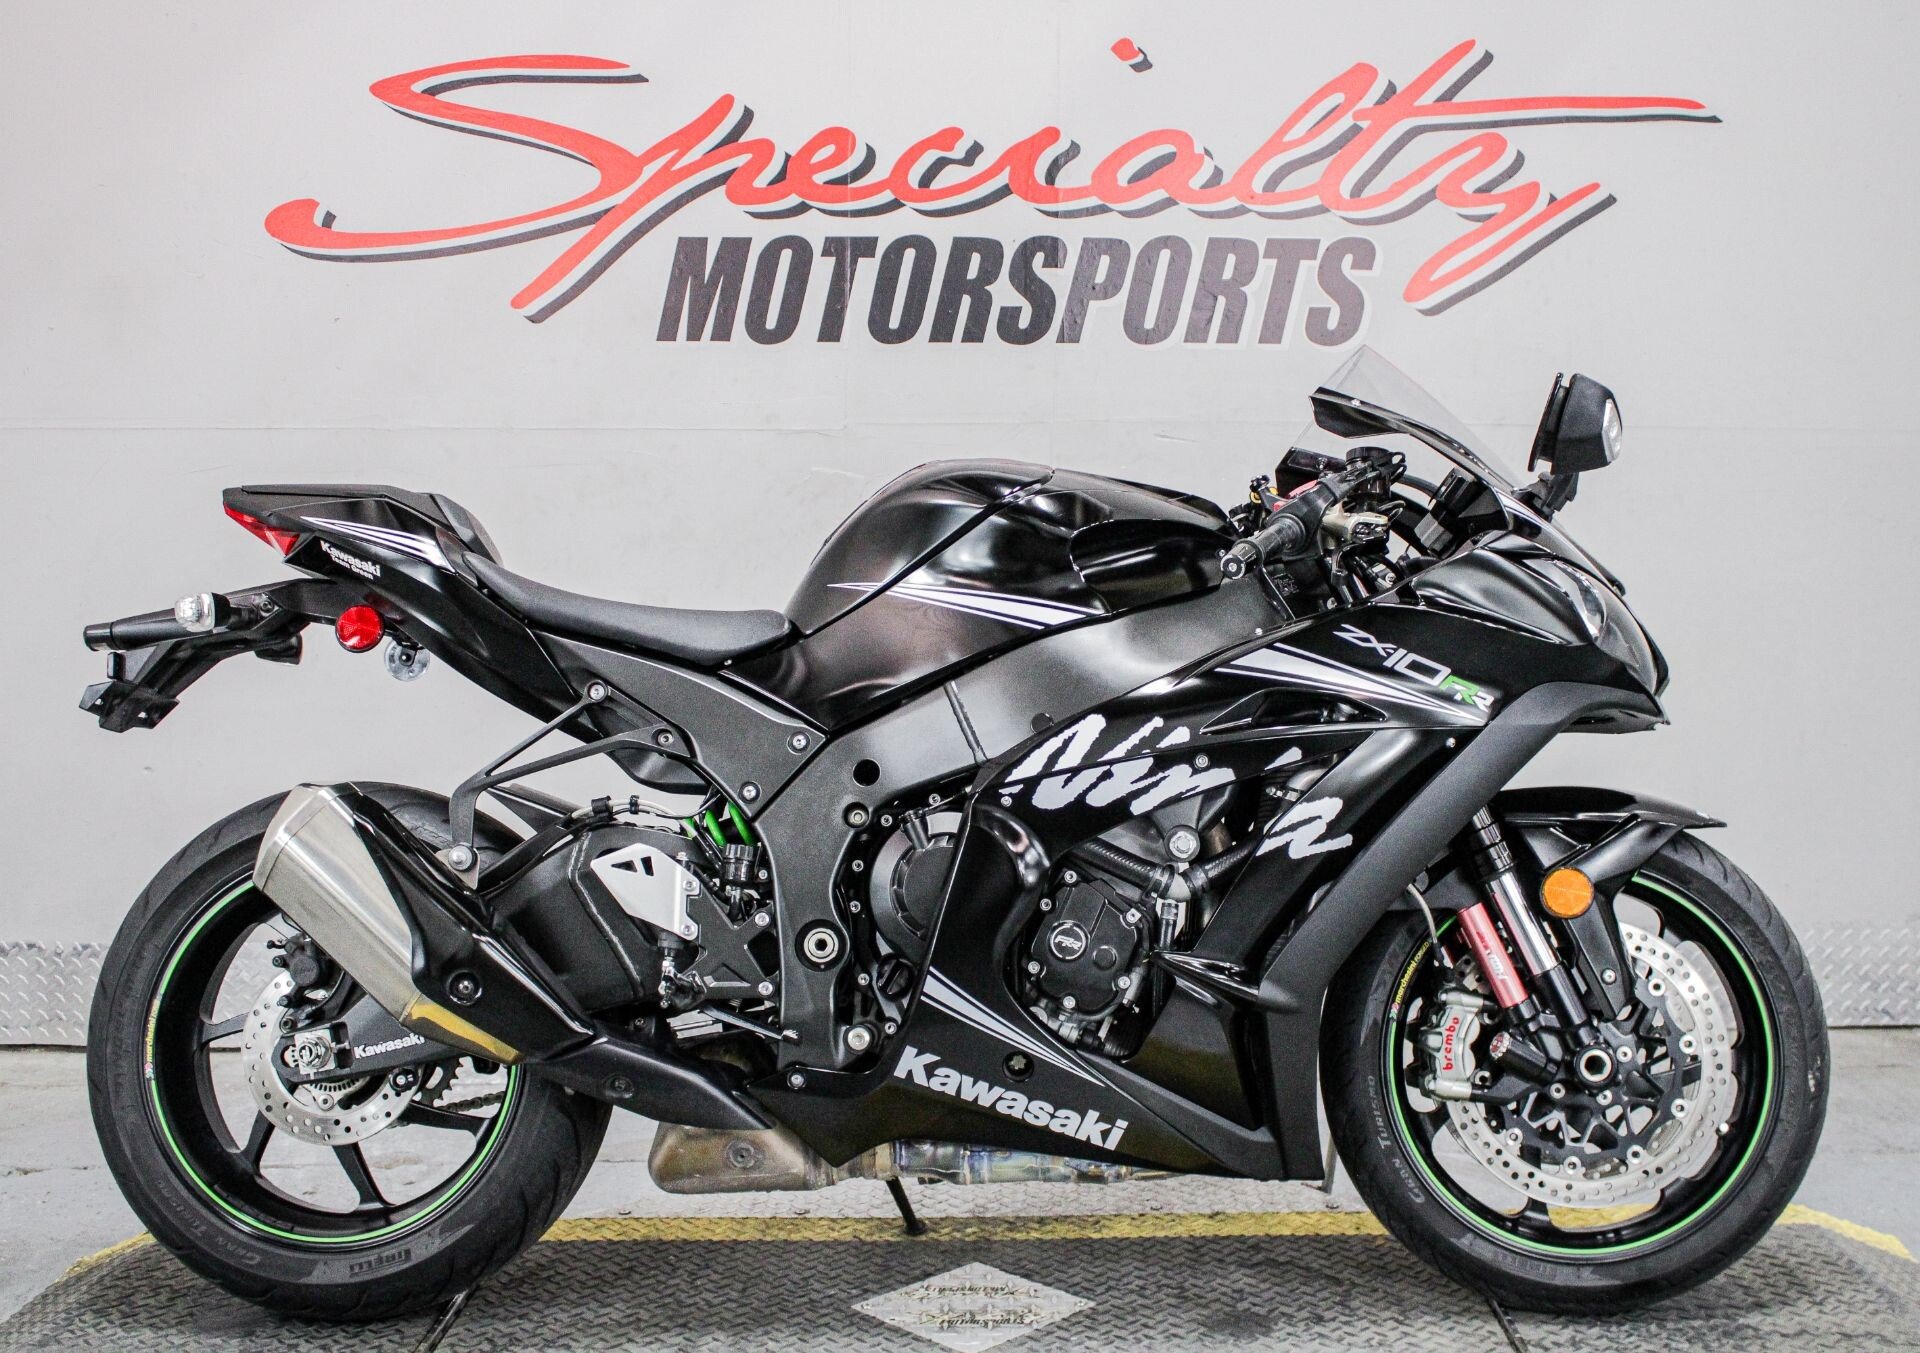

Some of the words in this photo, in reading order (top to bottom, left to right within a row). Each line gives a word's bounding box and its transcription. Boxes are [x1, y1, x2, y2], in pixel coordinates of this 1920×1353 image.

[264, 38, 1722, 324] Specialty
[656, 235, 1376, 344] MOTORSPORTS
[320, 540, 381, 577] Kawasaki
[353, 1032, 425, 1059] Kawasaki
[1442, 1016, 1460, 1072] brembo
[893, 1045, 1129, 1151] Kawasaki
